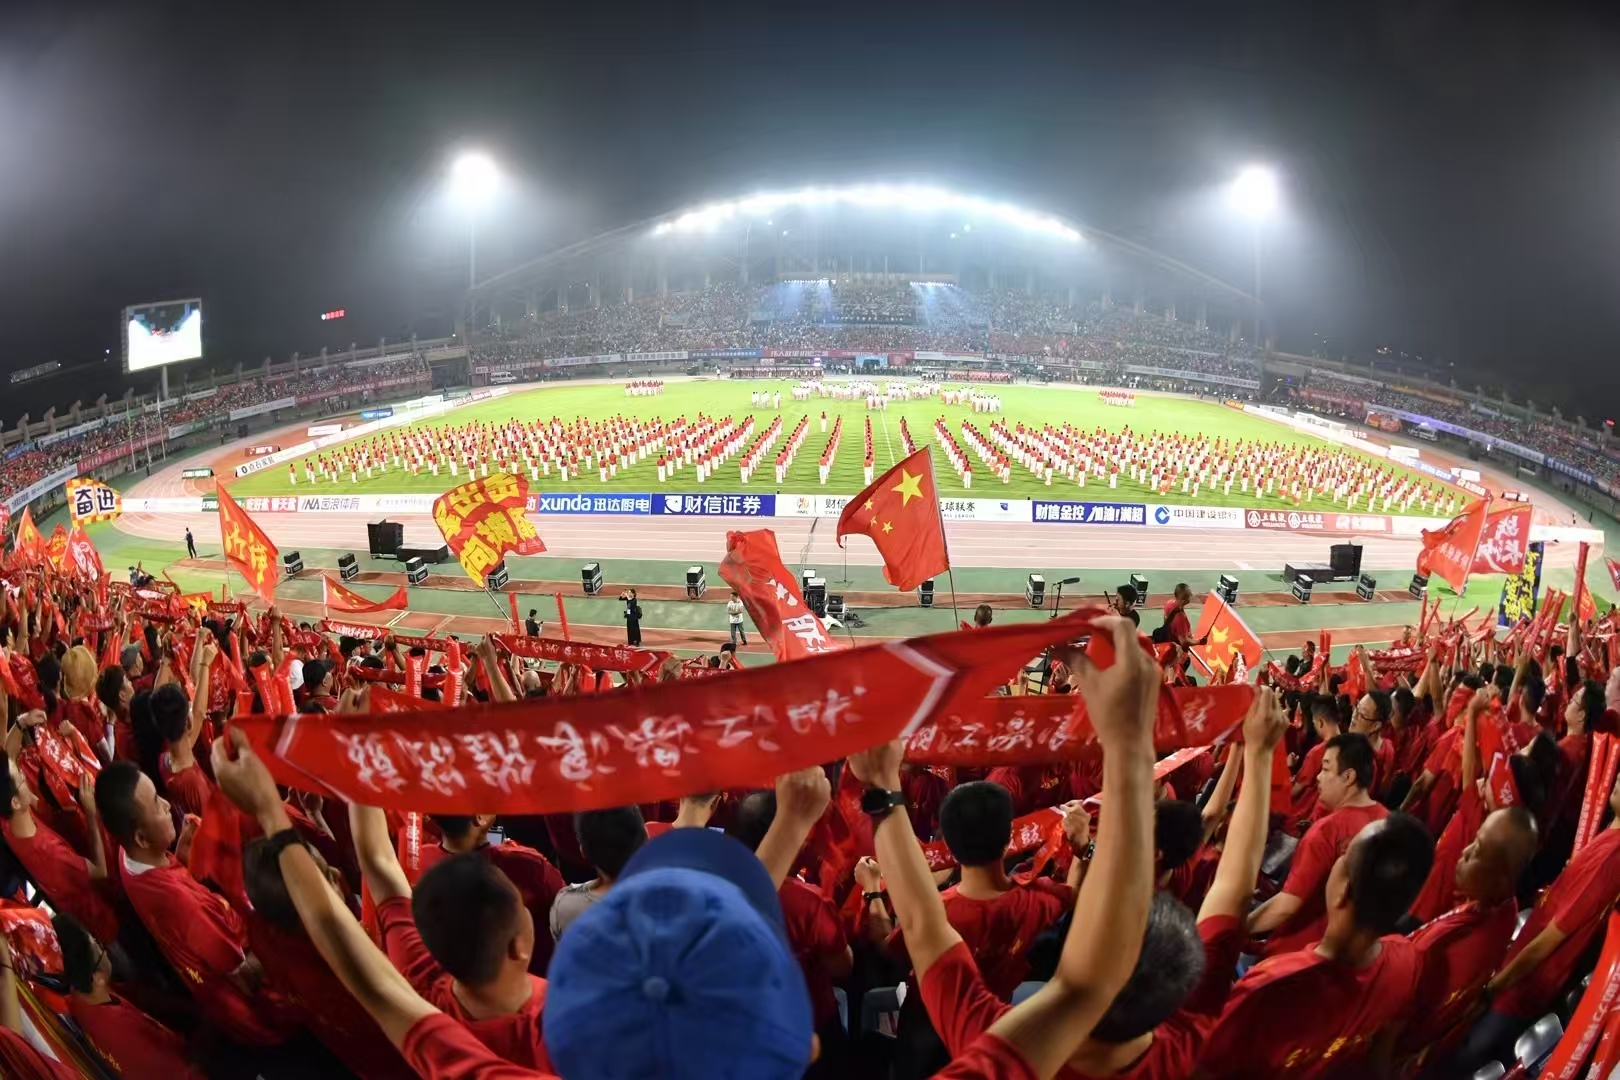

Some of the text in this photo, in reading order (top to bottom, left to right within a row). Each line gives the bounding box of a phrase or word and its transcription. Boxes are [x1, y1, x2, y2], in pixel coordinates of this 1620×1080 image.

[540, 494, 591, 512] xunda
[593, 497, 649, 512] 迅达厨电
[684, 495, 761, 514] 财信证券
[1035, 504, 1085, 520] 财信金控
[1173, 508, 1238, 521] 中国建设银行
